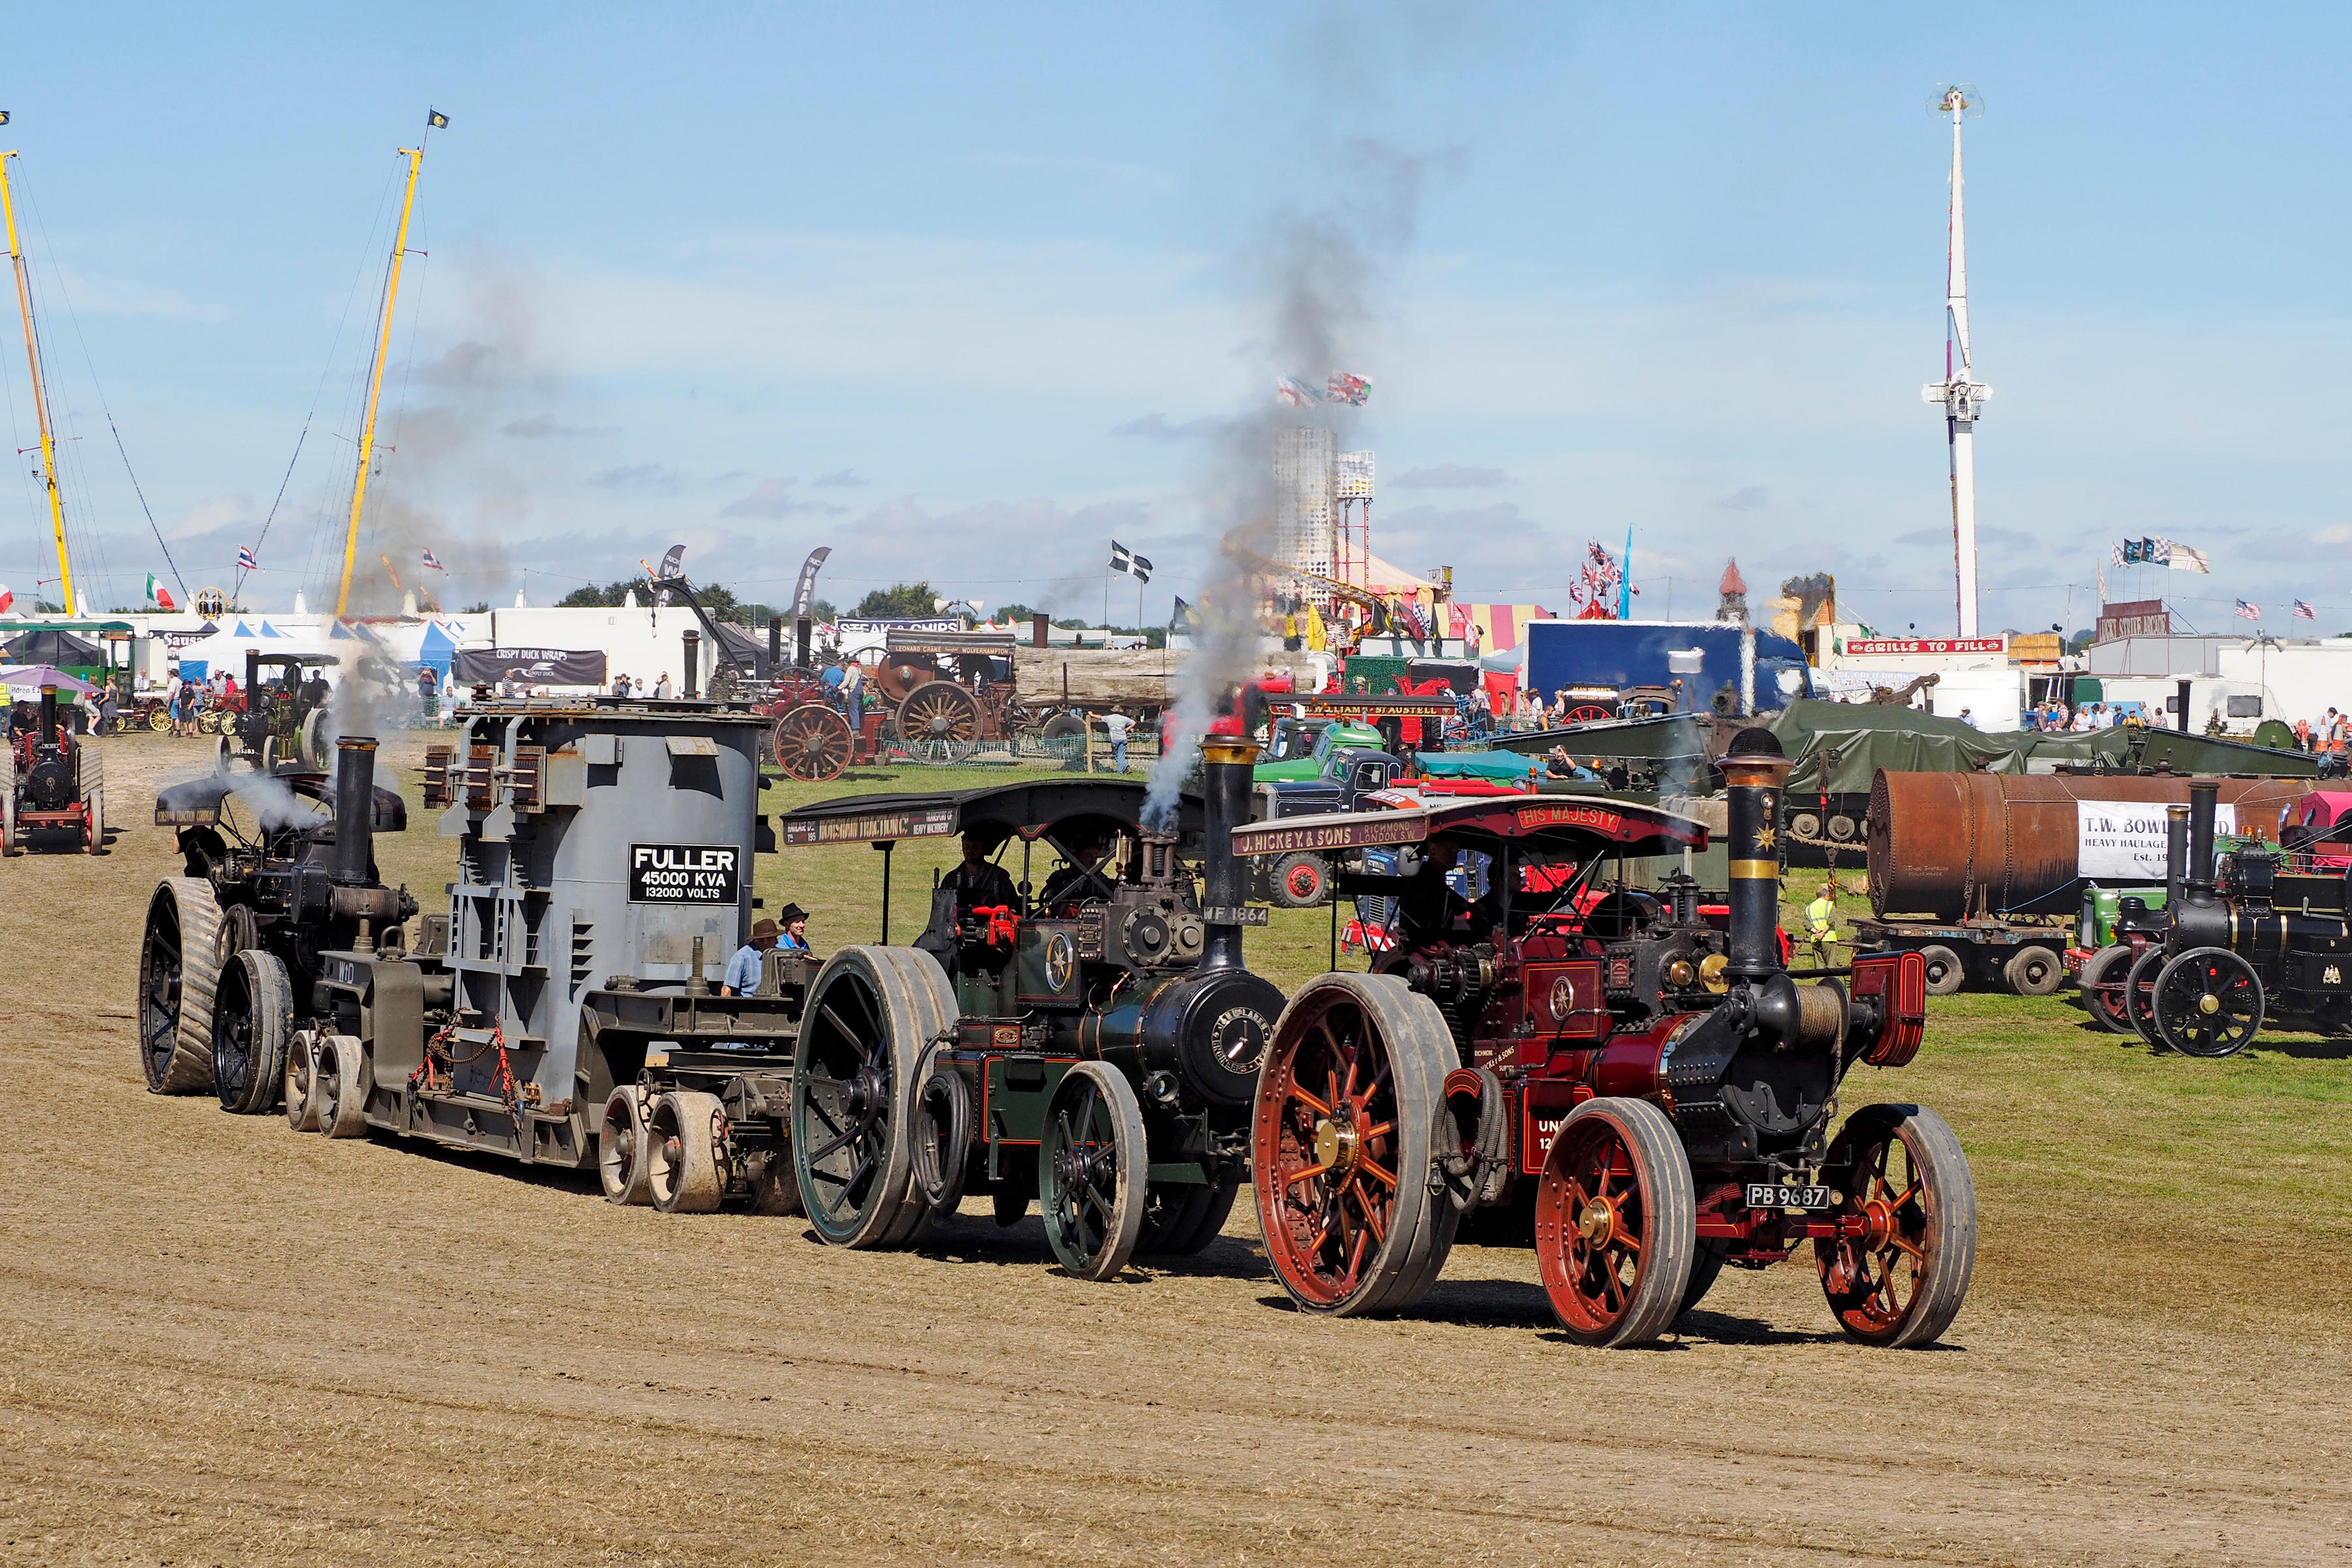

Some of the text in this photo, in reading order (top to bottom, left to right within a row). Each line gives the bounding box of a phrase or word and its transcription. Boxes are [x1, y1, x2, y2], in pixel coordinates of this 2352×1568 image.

[808, 557, 823, 566] DUC
[658, 563, 678, 608] WAP
[2099, 614, 2167, 642] LUCKY STRIKE ARCADE
[497, 649, 568, 661] CRISPY DUCK WRAPS
[1864, 642, 1987, 653] GRILLS TO FILL
[1313, 704, 1368, 713] WLLIAMS
[1390, 706, 1437, 715] AUSTELL
[1524, 806, 1616, 828] HIS MAJESTY
[819, 816, 858, 841] HORSHAM
[859, 813, 899, 838] TRACTION
[913, 822, 949, 835] HEAVY MACHINERY
[2085, 818, 2116, 833] T.W.
[1243, 836, 1252, 852] J.
[1306, 832, 1314, 847] &
[1317, 826, 1352, 847] SONS
[2085, 838, 2167, 849] HEAVY HAULAGE
[635, 848, 734, 871] FULLER
[2134, 853, 2152, 861] Est.
[641, 871, 727, 887] 45000 KVA
[645, 887, 720, 898] 132000 VOLTS
[1232, 907, 1267, 922] 1864
[1498, 1054, 1503, 1062] &
[1501, 1045, 1514, 1060] SONS
[1539, 1120, 1563, 1132] UN
[1752, 1187, 1825, 1206] PB 9687
